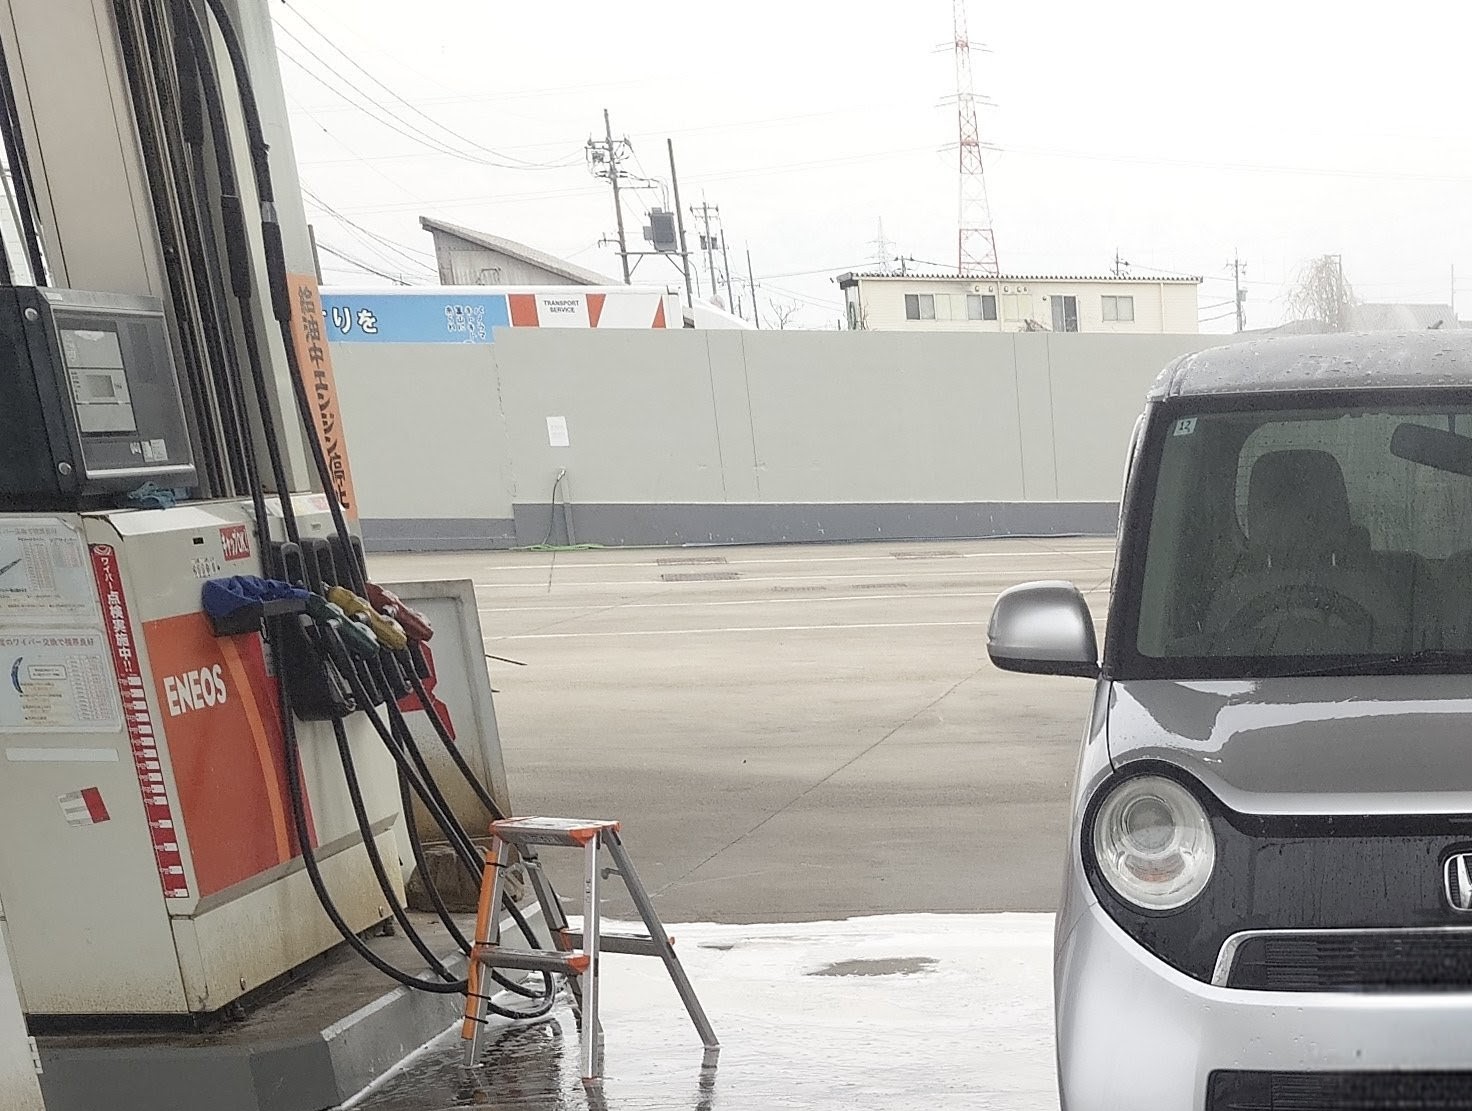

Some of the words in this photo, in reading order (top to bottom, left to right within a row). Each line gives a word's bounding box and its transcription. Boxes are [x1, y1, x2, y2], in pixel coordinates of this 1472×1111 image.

[322, 306, 379, 335] りを
[1179, 420, 1191, 431] 12
[163, 664, 227, 717] ENEOS
